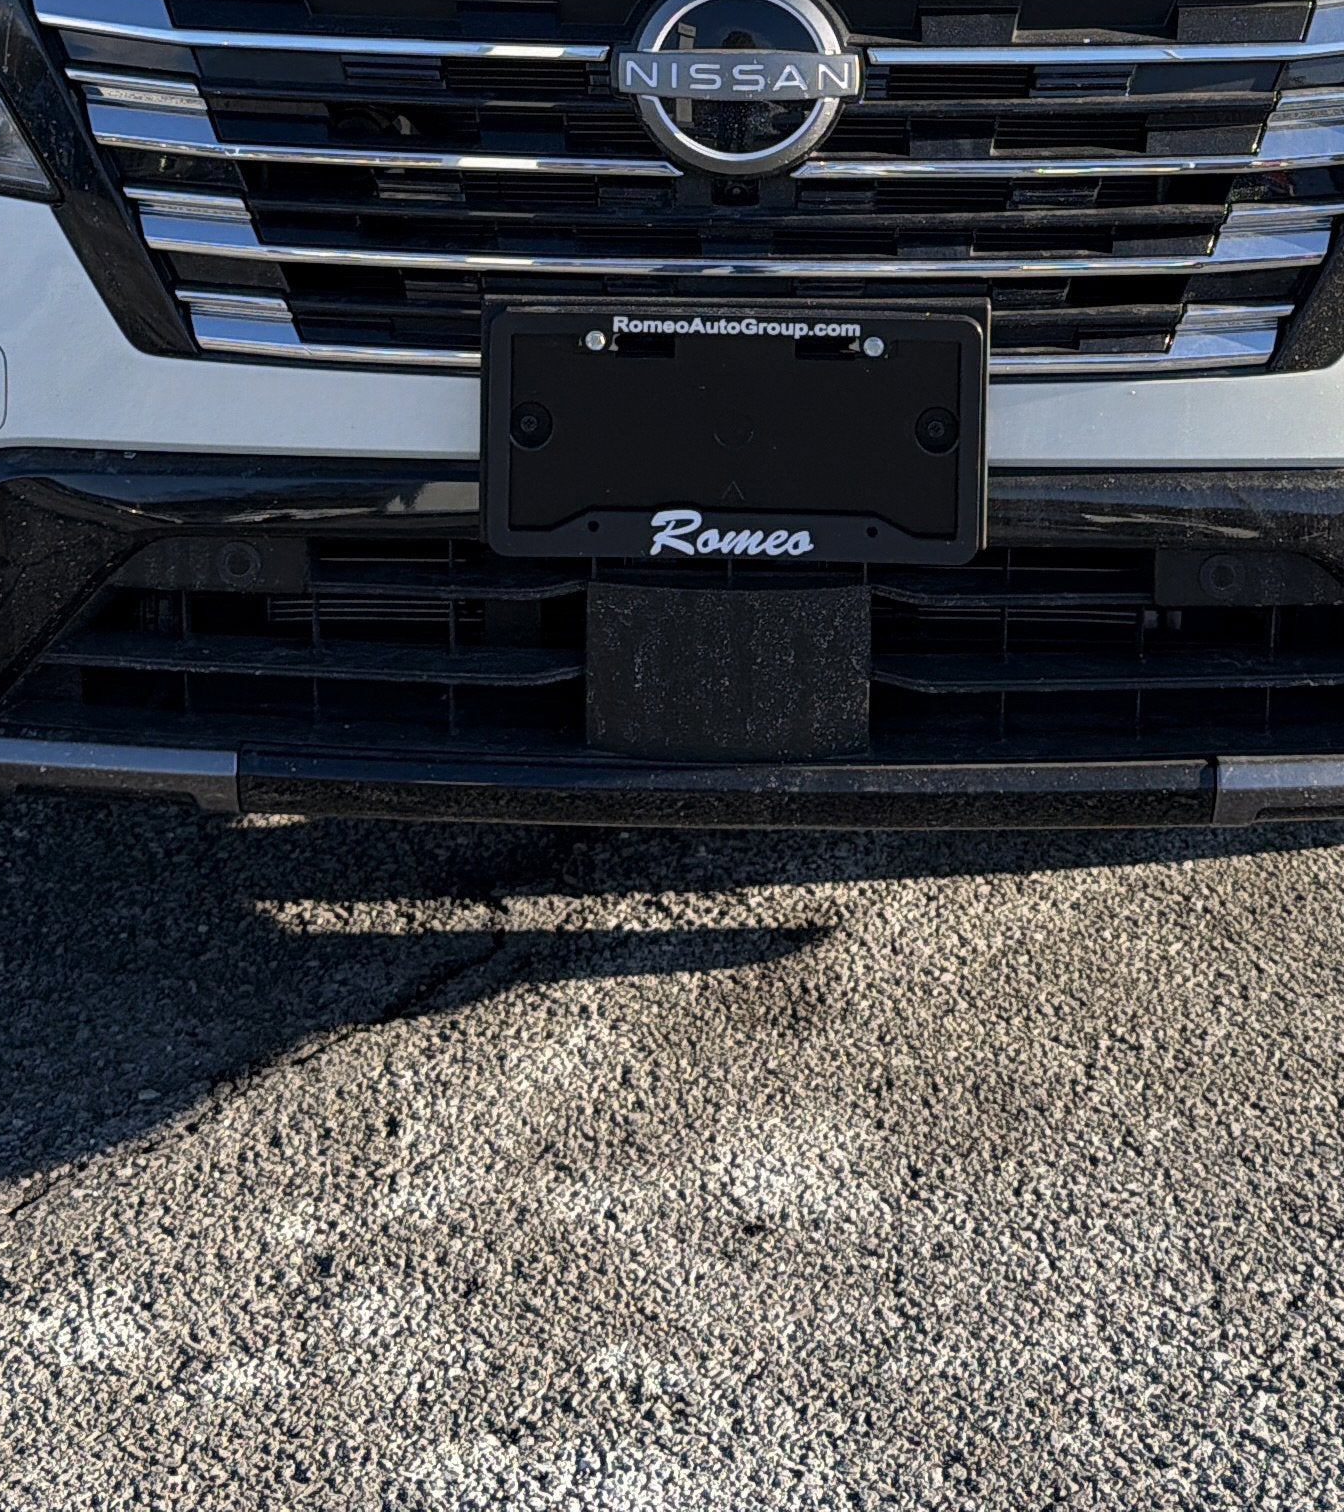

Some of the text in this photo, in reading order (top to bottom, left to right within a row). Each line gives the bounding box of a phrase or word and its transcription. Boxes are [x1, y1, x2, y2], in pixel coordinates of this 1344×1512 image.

[625, 59, 849, 92] NISSAN
[612, 315, 861, 339] RomeoAutoGroup.com
[649, 509, 815, 557] Romeo
